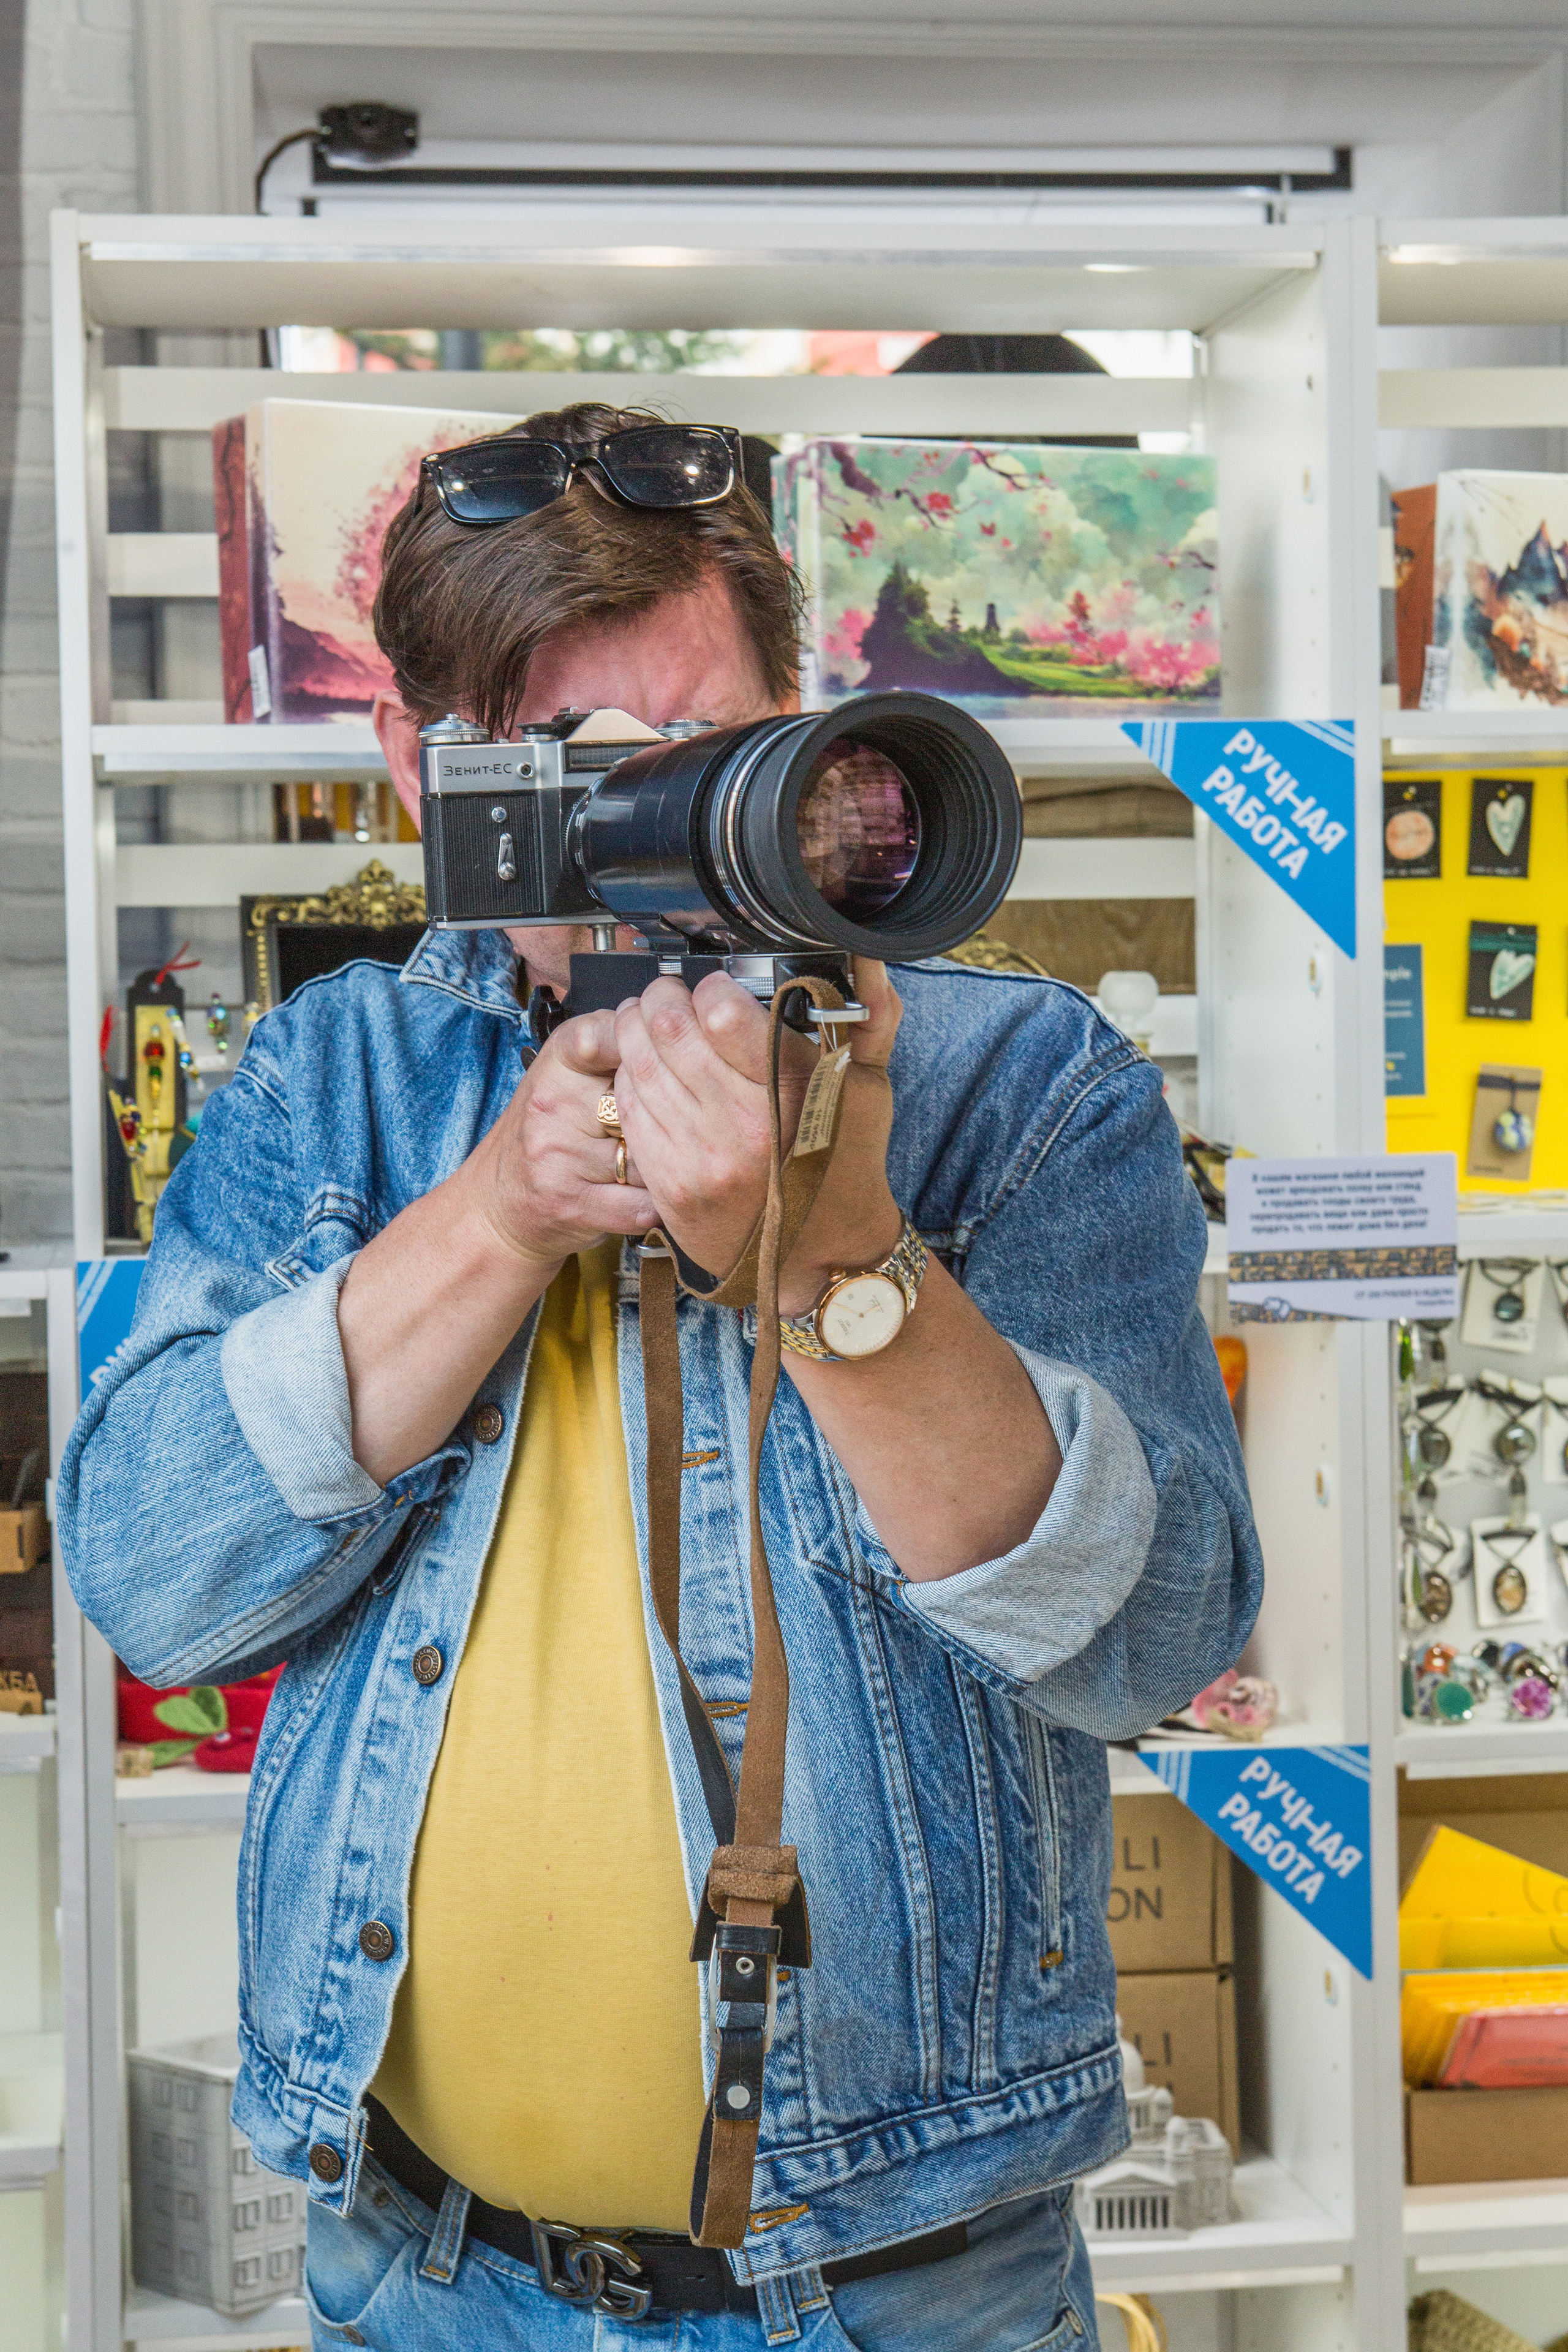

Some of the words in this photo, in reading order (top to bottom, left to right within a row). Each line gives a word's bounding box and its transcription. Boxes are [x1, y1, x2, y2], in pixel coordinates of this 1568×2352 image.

[1202, 765, 1309, 879] РАБОТА
[1224, 728, 1347, 854] РУЧНАЯ
[1219, 1793, 1324, 1903] РАБОТА
[1240, 1757, 1362, 1877] РУЧНАЯ
